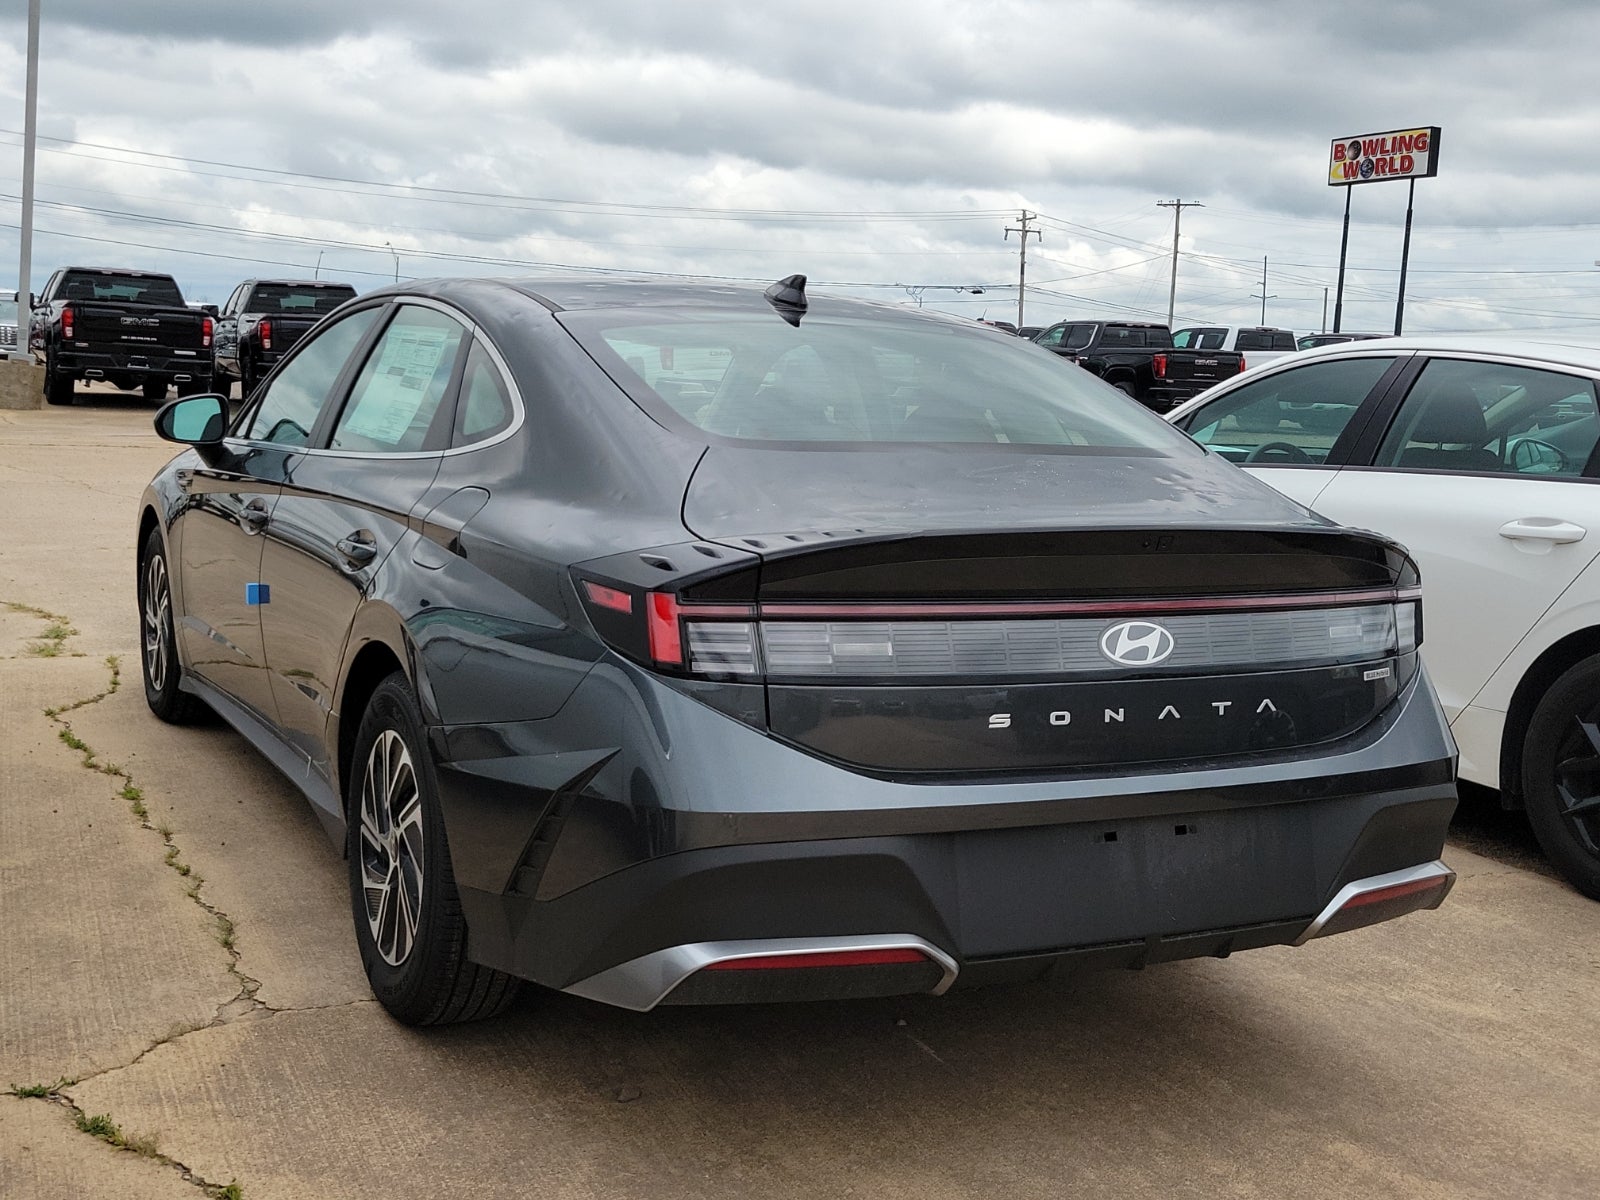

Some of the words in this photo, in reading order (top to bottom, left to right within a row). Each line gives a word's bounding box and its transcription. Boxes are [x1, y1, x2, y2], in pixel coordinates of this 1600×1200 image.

[1333, 133, 1429, 162] BOWLING
[1343, 154, 1414, 179] WORLD
[121, 317, 159, 326] GMC
[988, 698, 1277, 729] SONATA
